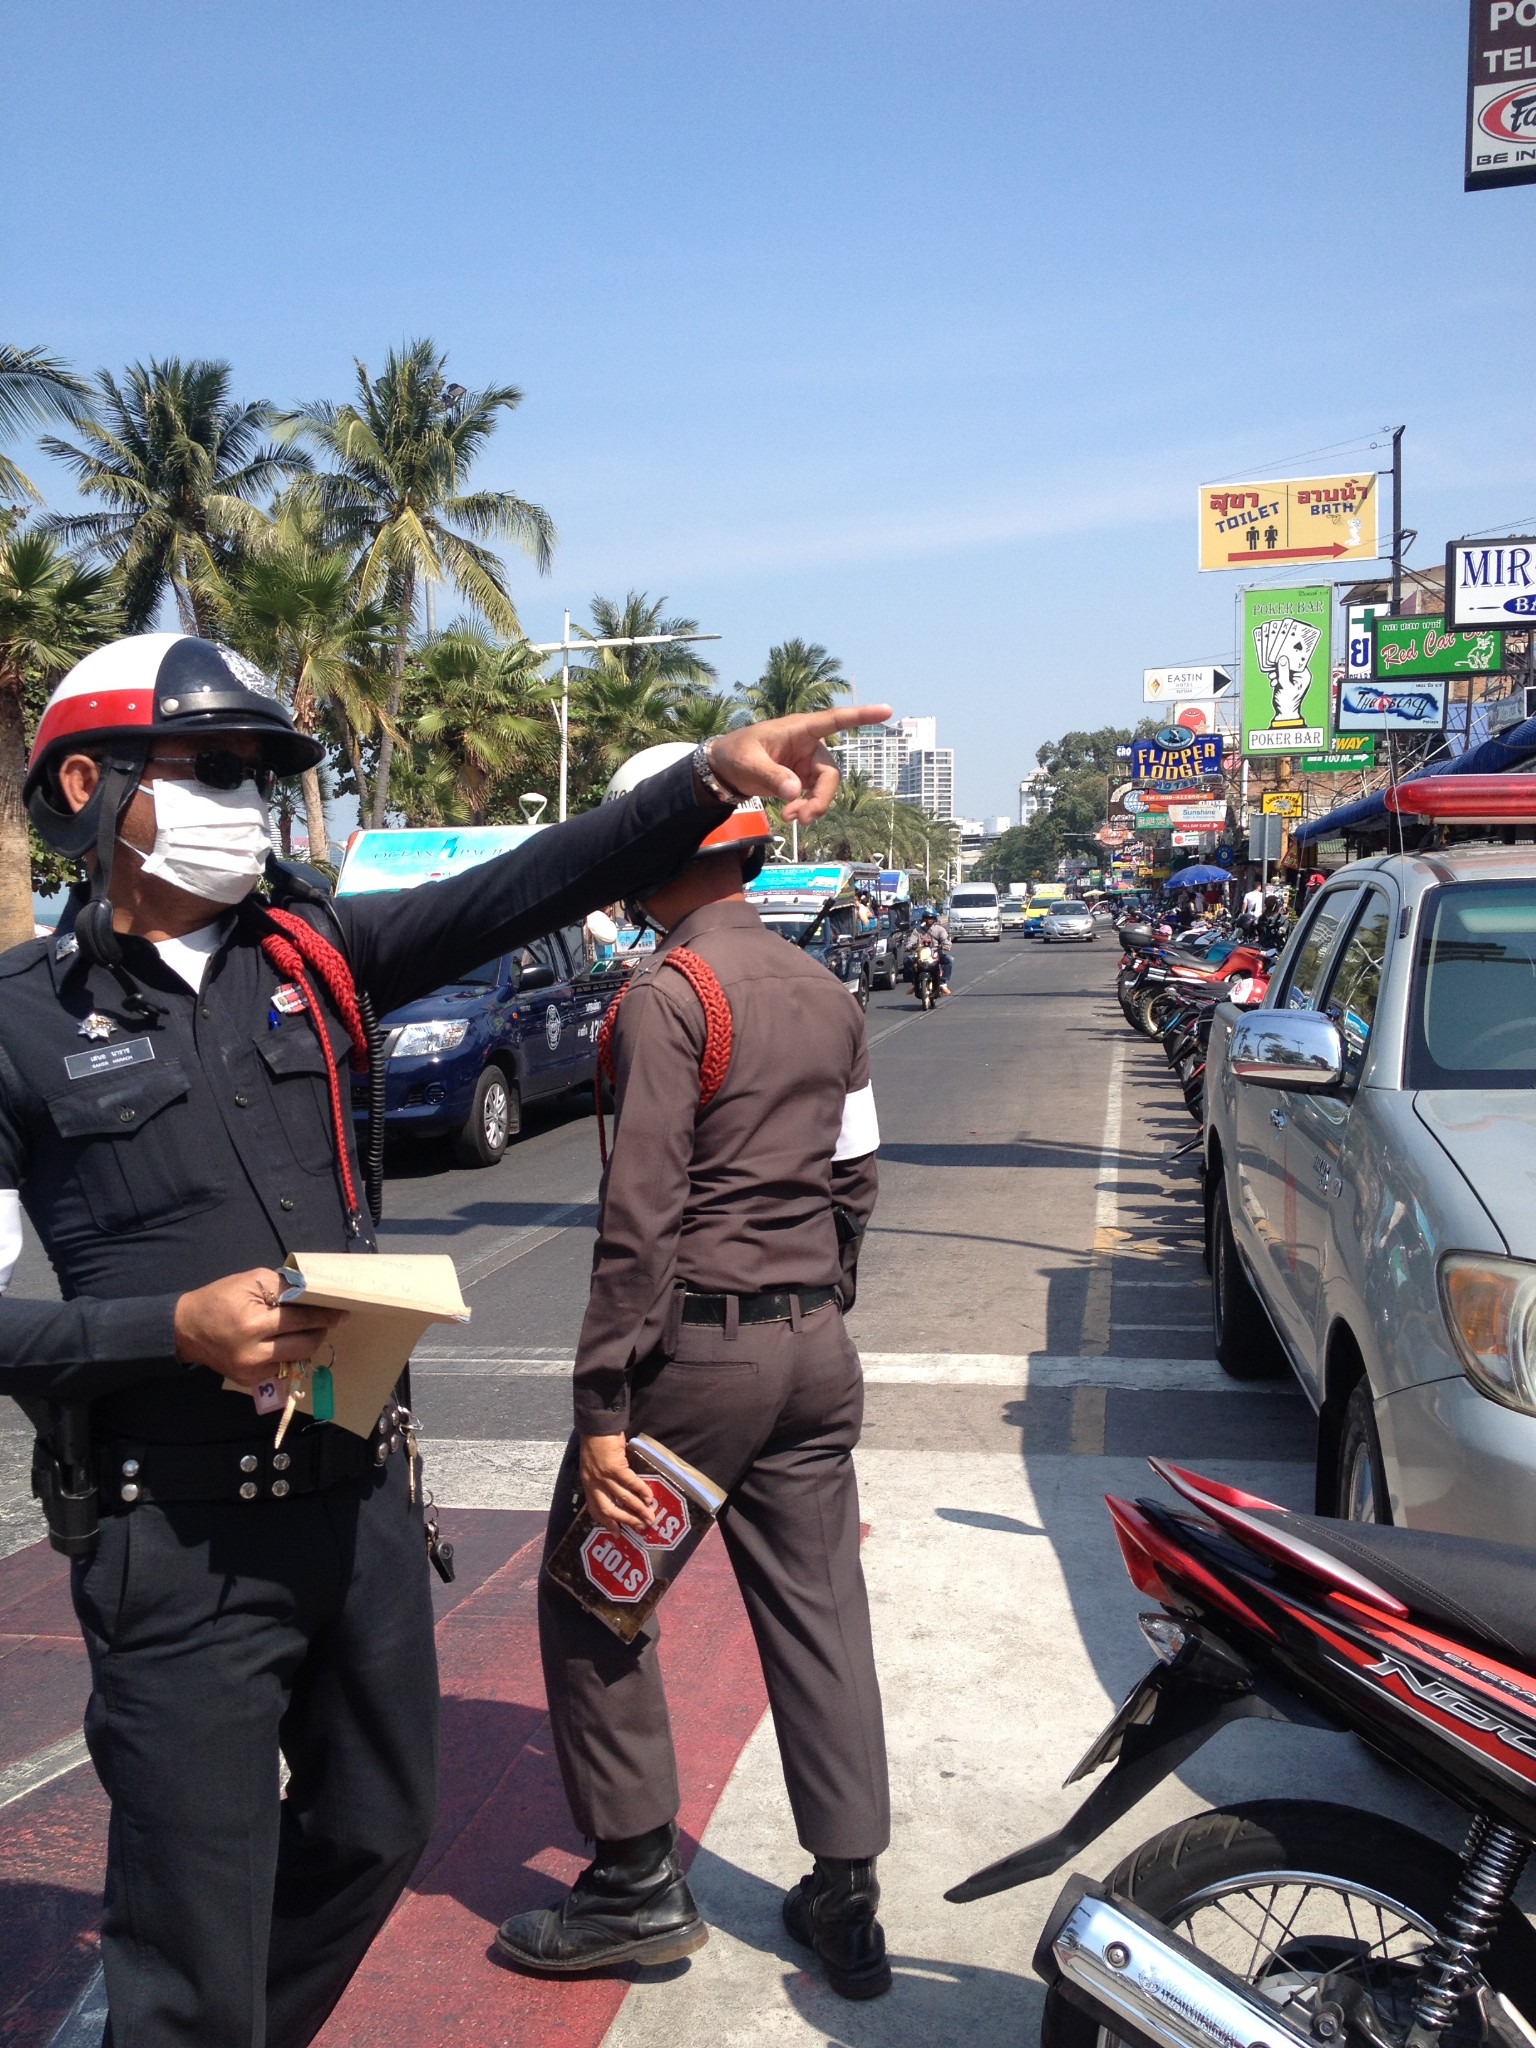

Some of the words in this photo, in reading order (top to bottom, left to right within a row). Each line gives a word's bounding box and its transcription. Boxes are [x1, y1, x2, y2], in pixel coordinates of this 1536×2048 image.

[1483, 45, 1536, 73] TEL
[1476, 152, 1509, 166] BE
[1298, 479, 1368, 504] อาบน้ำ
[1210, 492, 1259, 517] สุขา
[1311, 503, 1354, 516] BATH
[1215, 501, 1280, 533] TOILET
[1253, 602, 1294, 616] POKER
[1297, 600, 1324, 614] BAR
[1381, 640, 1418, 670] Red
[1424, 629, 1456, 658] Cat
[1167, 673, 1203, 683] EASTIN
[1251, 733, 1292, 746] POKER
[1294, 731, 1321, 745] BAR
[1138, 743, 1216, 766] FLIPPER
[1140, 761, 1204, 780] LODGE
[374, 849, 433, 860] OCEAN
[591, 1543, 644, 1592] STOP
